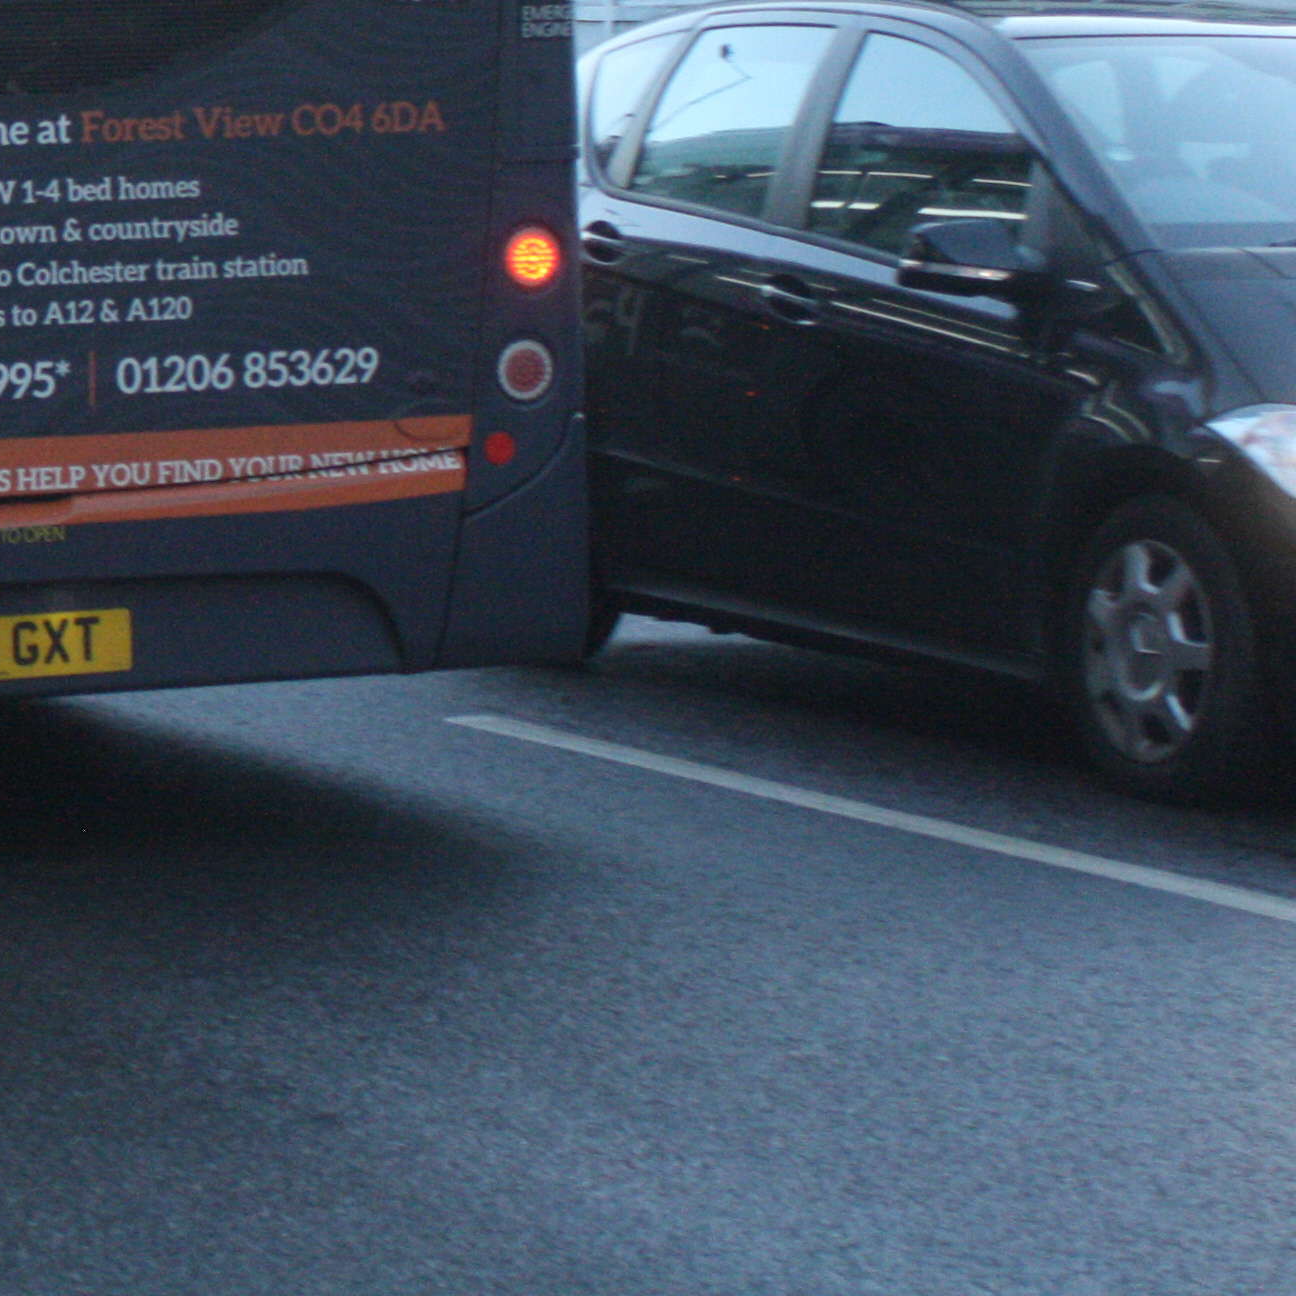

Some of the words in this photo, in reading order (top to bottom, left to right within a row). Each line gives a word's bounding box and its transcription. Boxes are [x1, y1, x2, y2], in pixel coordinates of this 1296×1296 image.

[36, 113, 72, 145] at
[80, 110, 186, 143] Forest
[193, 107, 284, 140] View
[292, 103, 364, 136] CO4
[371, 100, 446, 134] 6DA
[22, 179, 61, 204] 1-4
[66, 177, 111, 202] bed
[118, 175, 200, 201] homes
[62, 218, 83, 242] &
[88, 212, 239, 243] countryside
[16, 260, 150, 287] Colchester
[155, 256, 218, 281] train
[223, 253, 308, 279] station
[11, 304, 37, 327] to
[43, 300, 95, 326] A12
[99, 298, 120, 323] &
[125, 296, 193, 322] A120
[116, 353, 235, 395] 01206
[243, 347, 380, 389] 853629
[16, 465, 86, 492] HELP
[90, 462, 151, 487] YOU
[158, 458, 223, 484] FIND
[229, 455, 304, 483] YOUR
[310, 452, 375, 479] NEW
[378, 446, 462, 473] HOME
[2, 527, 23, 544] TO
[24, 526, 65, 543] OPEN
[13, 617, 100, 666] GXT
